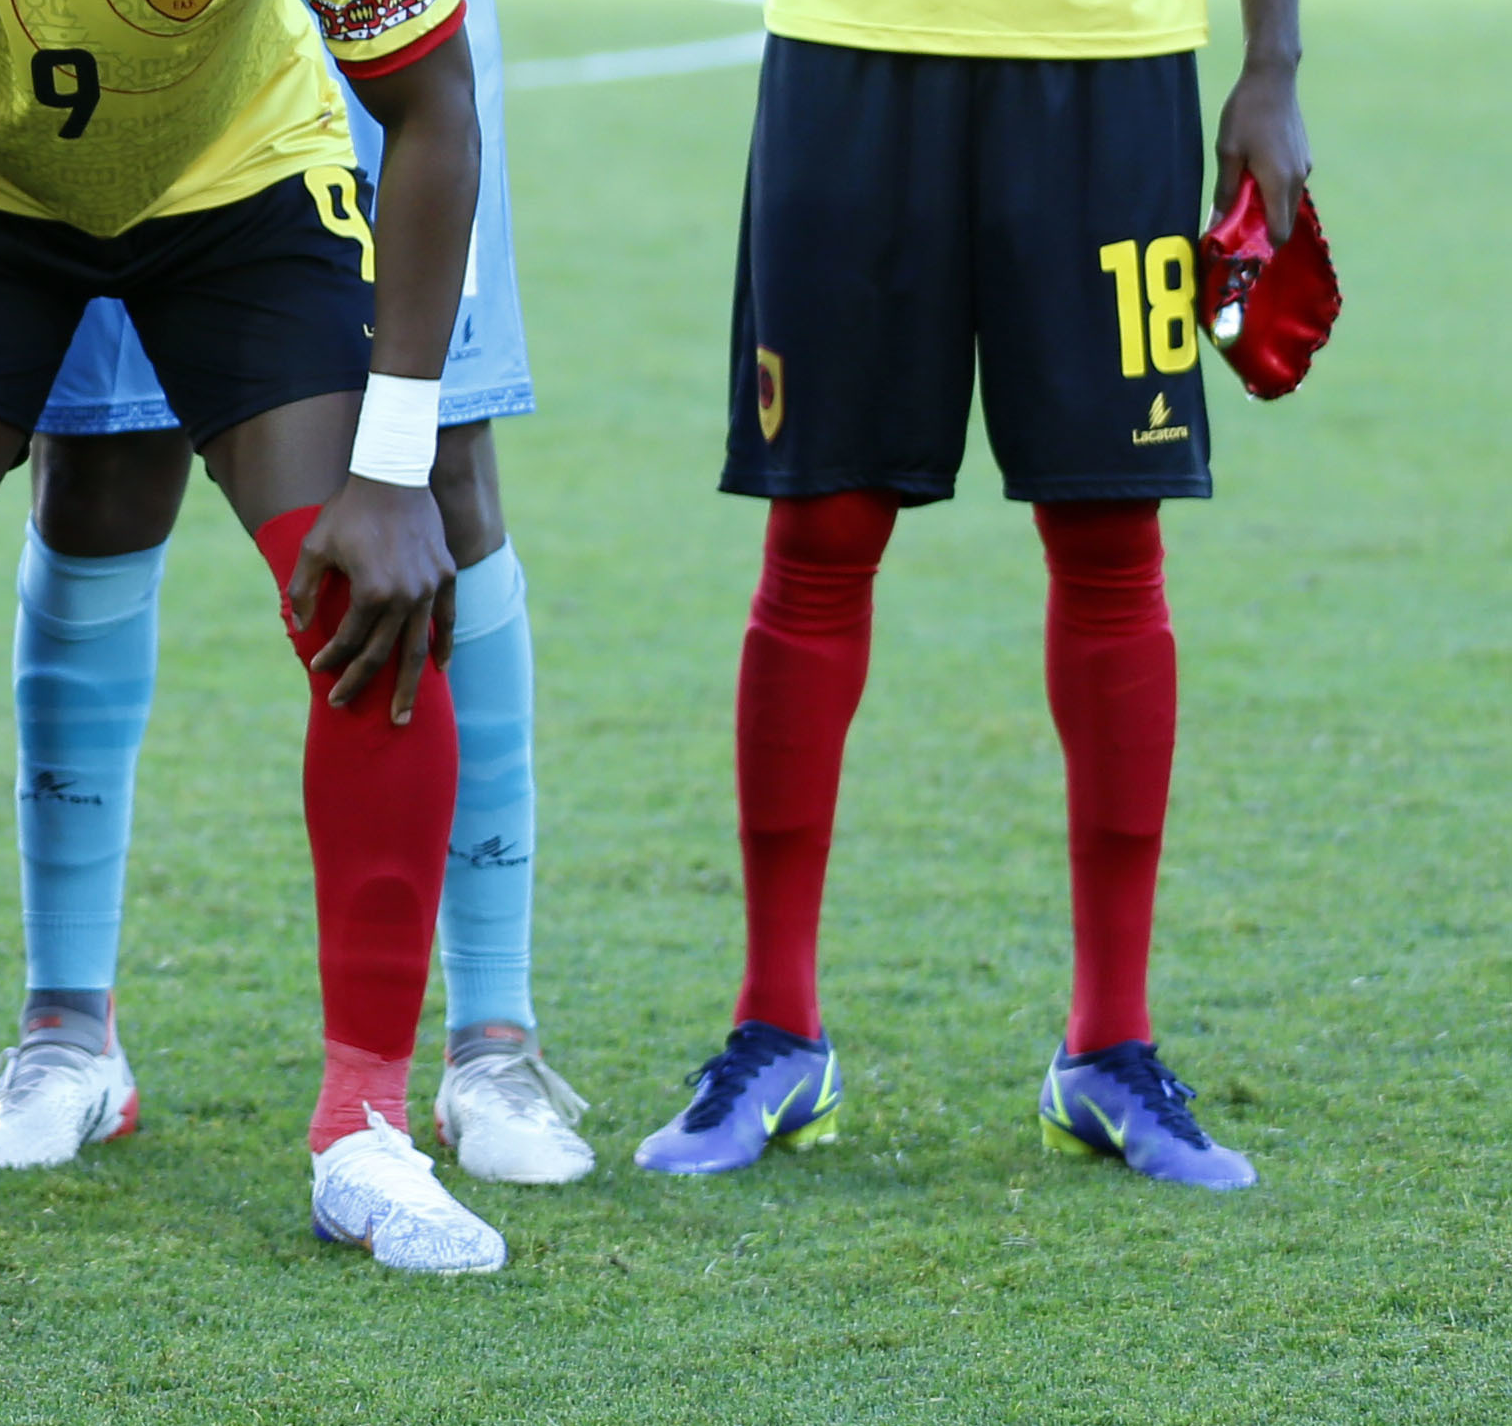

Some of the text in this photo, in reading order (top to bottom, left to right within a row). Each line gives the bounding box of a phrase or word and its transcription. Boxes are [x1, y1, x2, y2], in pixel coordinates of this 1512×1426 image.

[30, 48, 101, 139] 9
[303, 166, 375, 283] 9
[1099, 235, 1199, 378] 18
